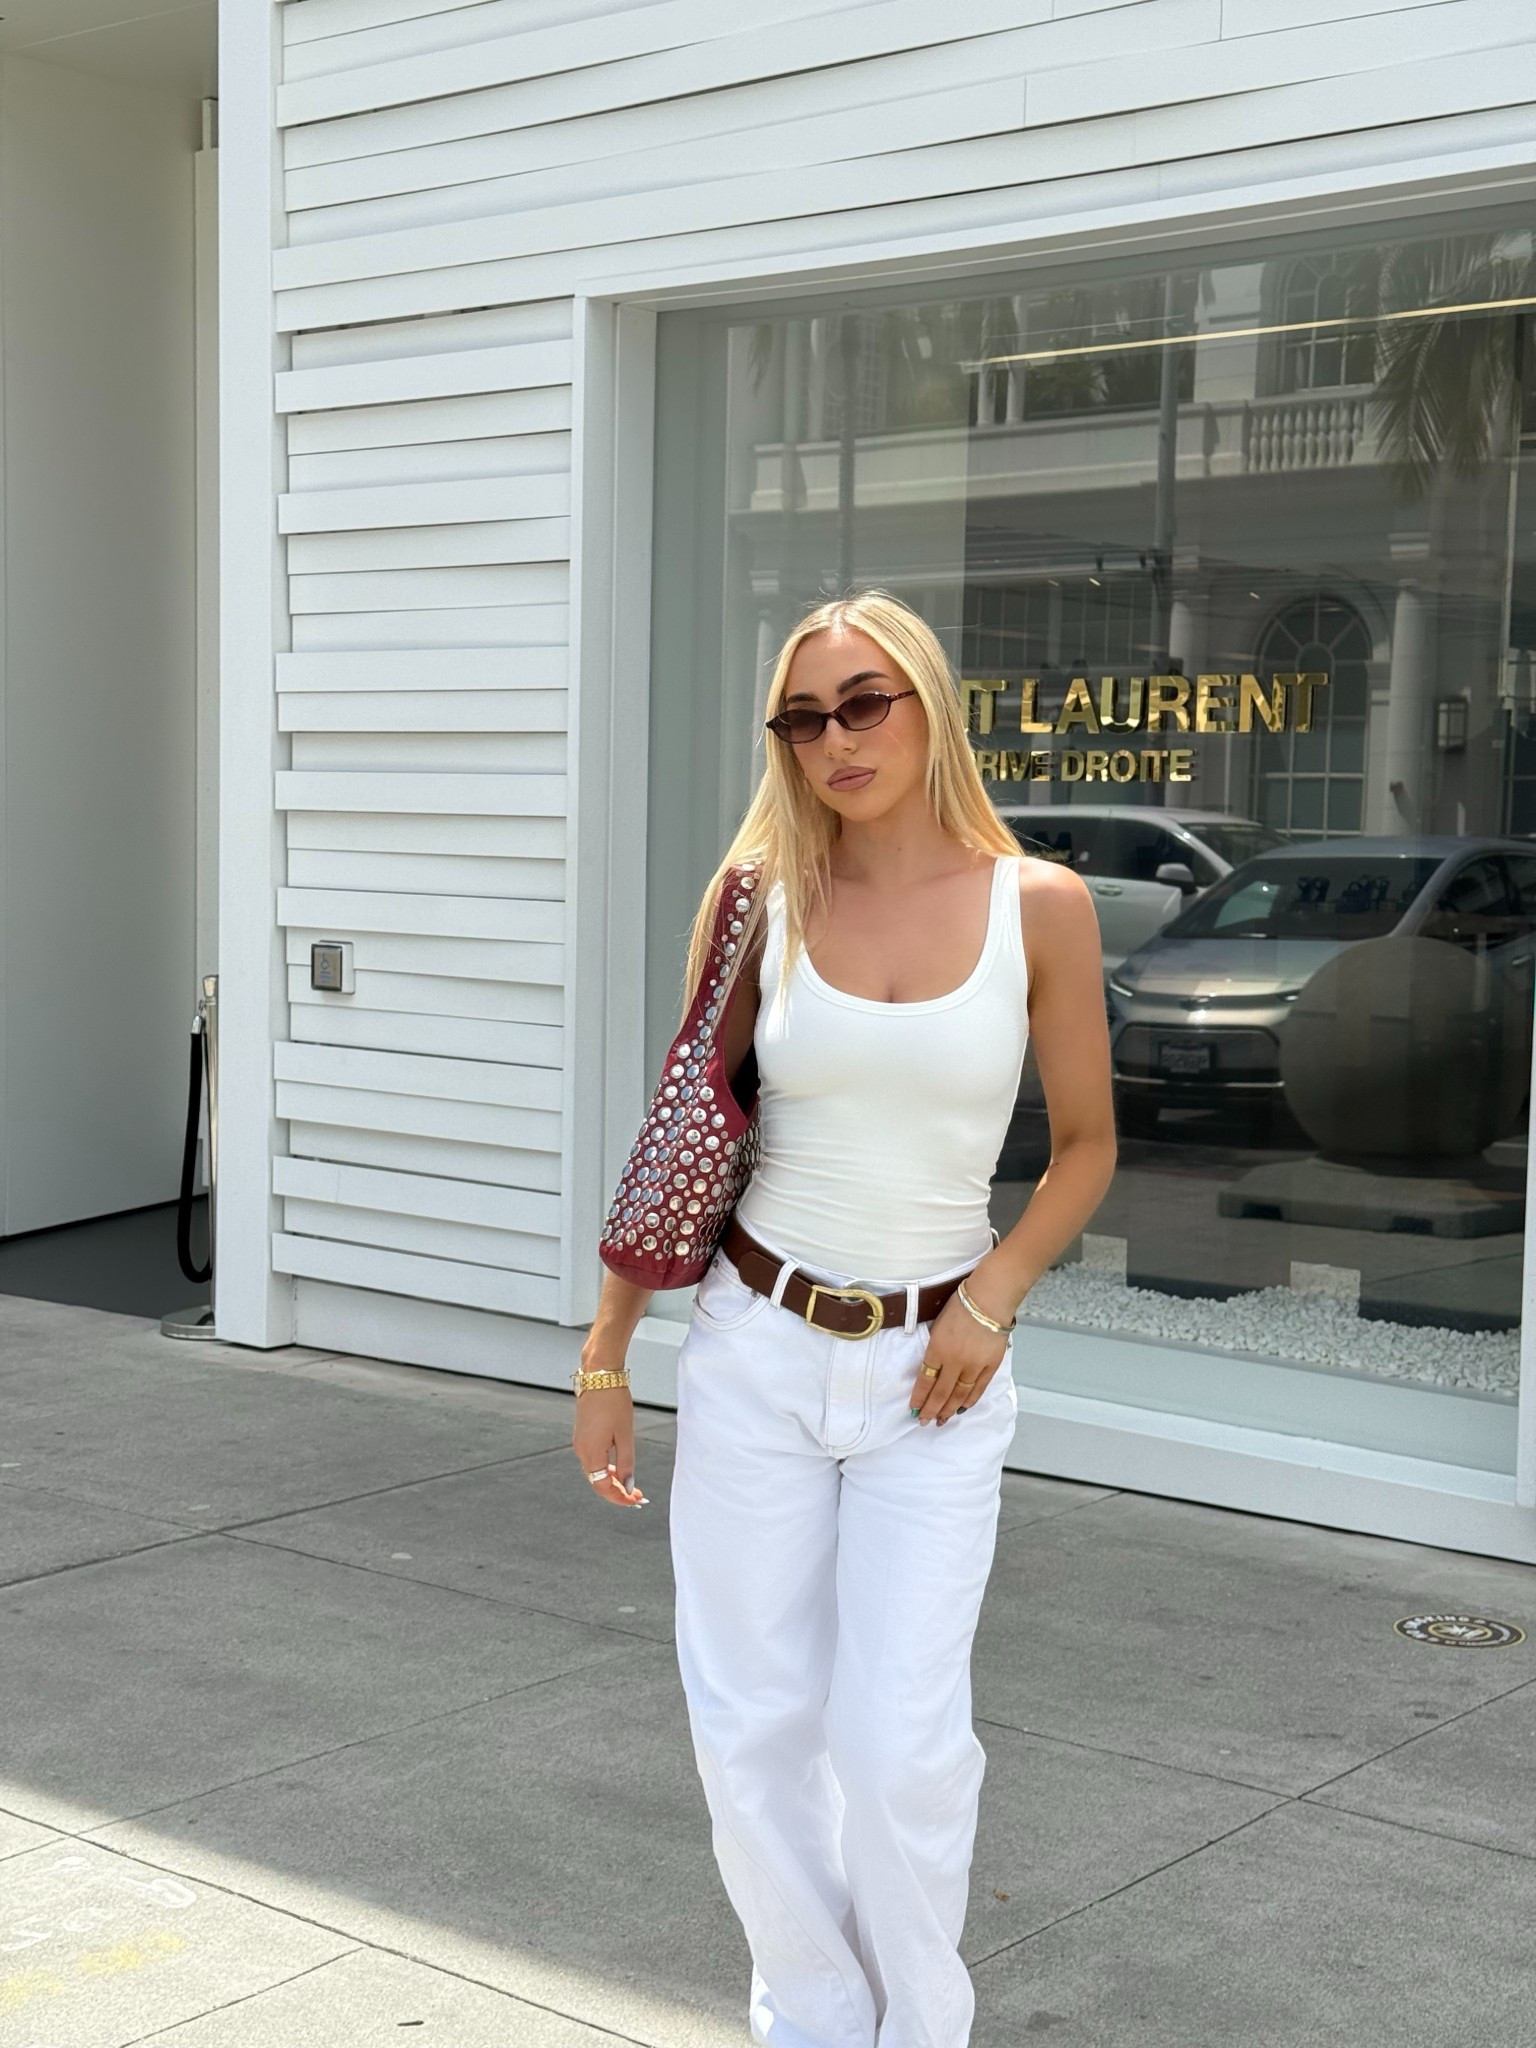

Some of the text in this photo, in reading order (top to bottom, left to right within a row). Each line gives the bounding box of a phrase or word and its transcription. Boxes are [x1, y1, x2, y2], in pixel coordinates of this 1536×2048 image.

[1020, 674, 1328, 734] LAURENT
[976, 750, 1195, 782] RIVE DROITE
